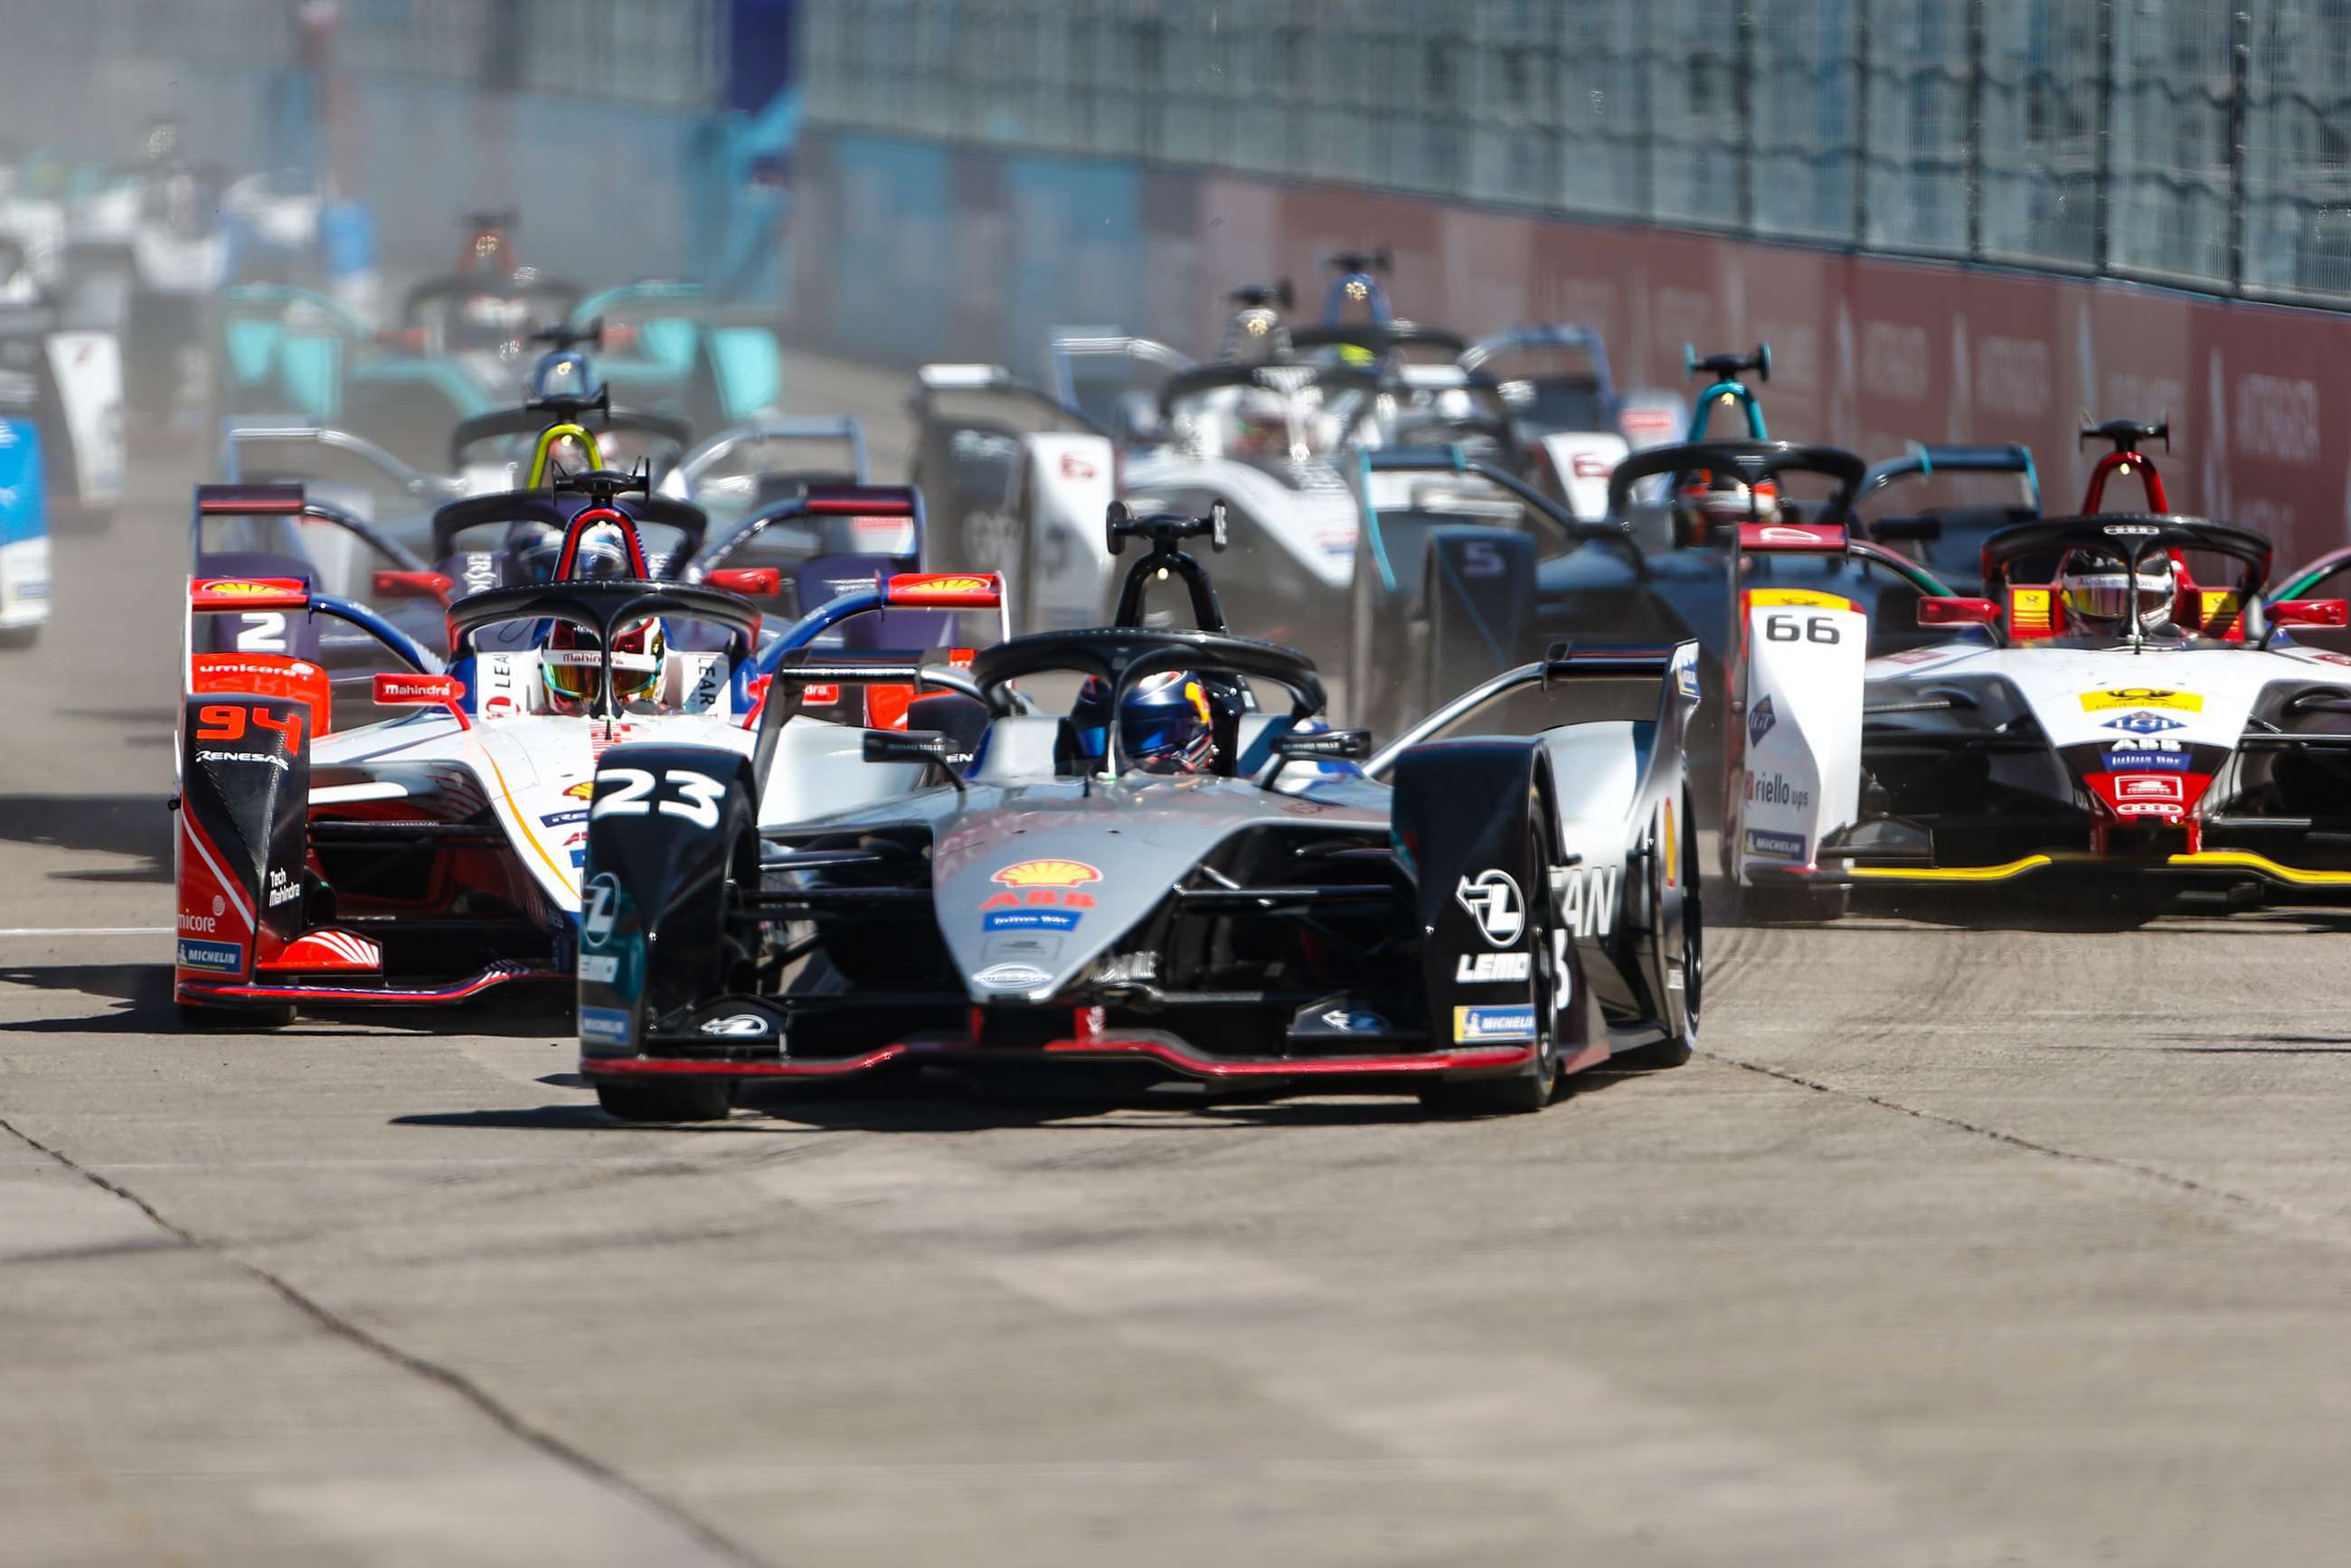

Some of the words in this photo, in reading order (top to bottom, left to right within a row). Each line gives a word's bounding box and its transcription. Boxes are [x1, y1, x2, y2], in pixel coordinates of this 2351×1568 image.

[1464, 543, 1504, 575] 5
[237, 612, 287, 650] 2
[1766, 614, 1840, 645] 66
[199, 663, 297, 677] umicore
[385, 683, 450, 695] Mahindra
[196, 705, 303, 757] 94
[2111, 738, 2181, 752] ABB
[195, 751, 289, 770] RENESAS
[591, 768, 726, 829] 23
[1756, 771, 1789, 804] riello
[1792, 789, 1808, 811] ups
[1756, 837, 1801, 854] MICHELIN
[270, 868, 287, 888] Tech
[269, 882, 301, 907] Mahindra
[979, 890, 1097, 911] ABB
[188, 949, 237, 964] MICHELIN
[1456, 952, 1531, 983] LEMO
